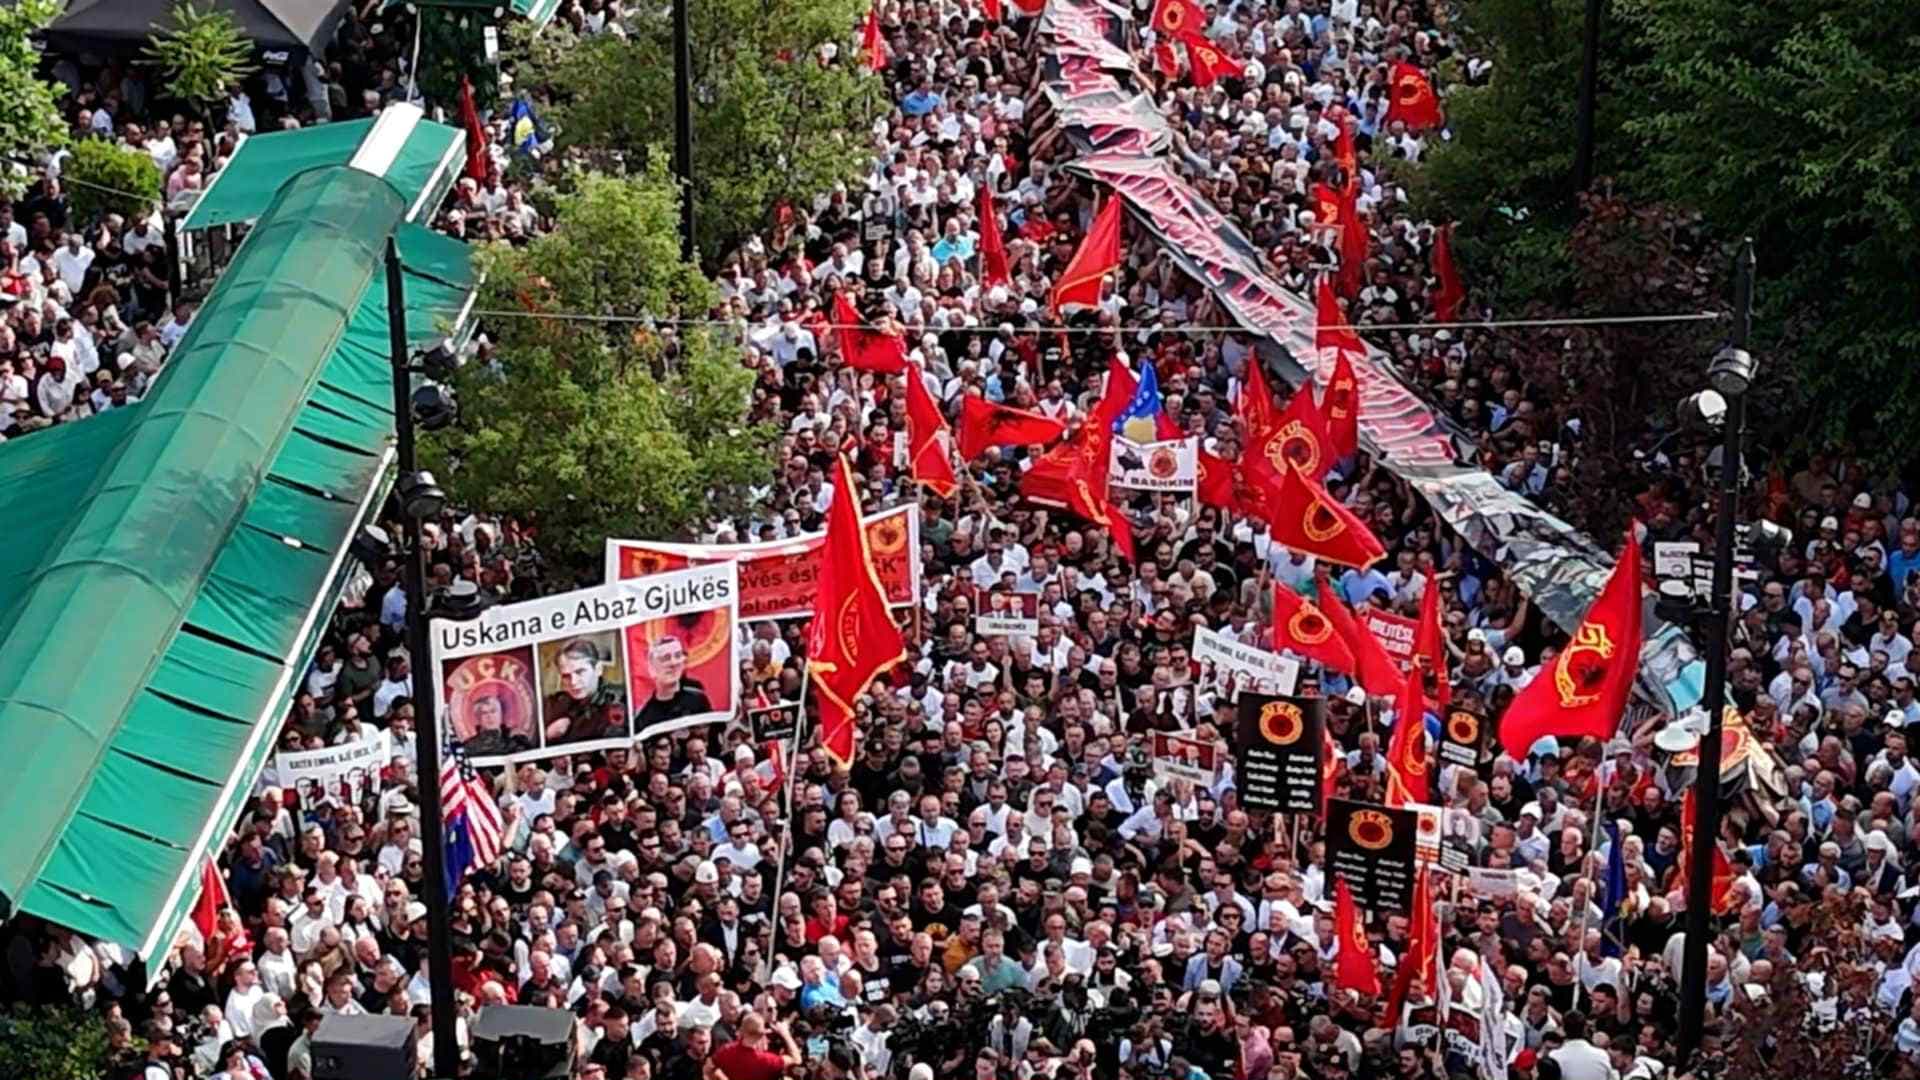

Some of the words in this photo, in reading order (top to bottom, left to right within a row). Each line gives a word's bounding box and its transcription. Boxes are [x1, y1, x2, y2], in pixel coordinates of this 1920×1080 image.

[1131, 477, 1193, 487] BASHKIM
[442, 616, 542, 650] Uskana
[552, 611, 565, 629] e
[574, 597, 638, 626] Abaz
[645, 576, 730, 613] Gjukës
